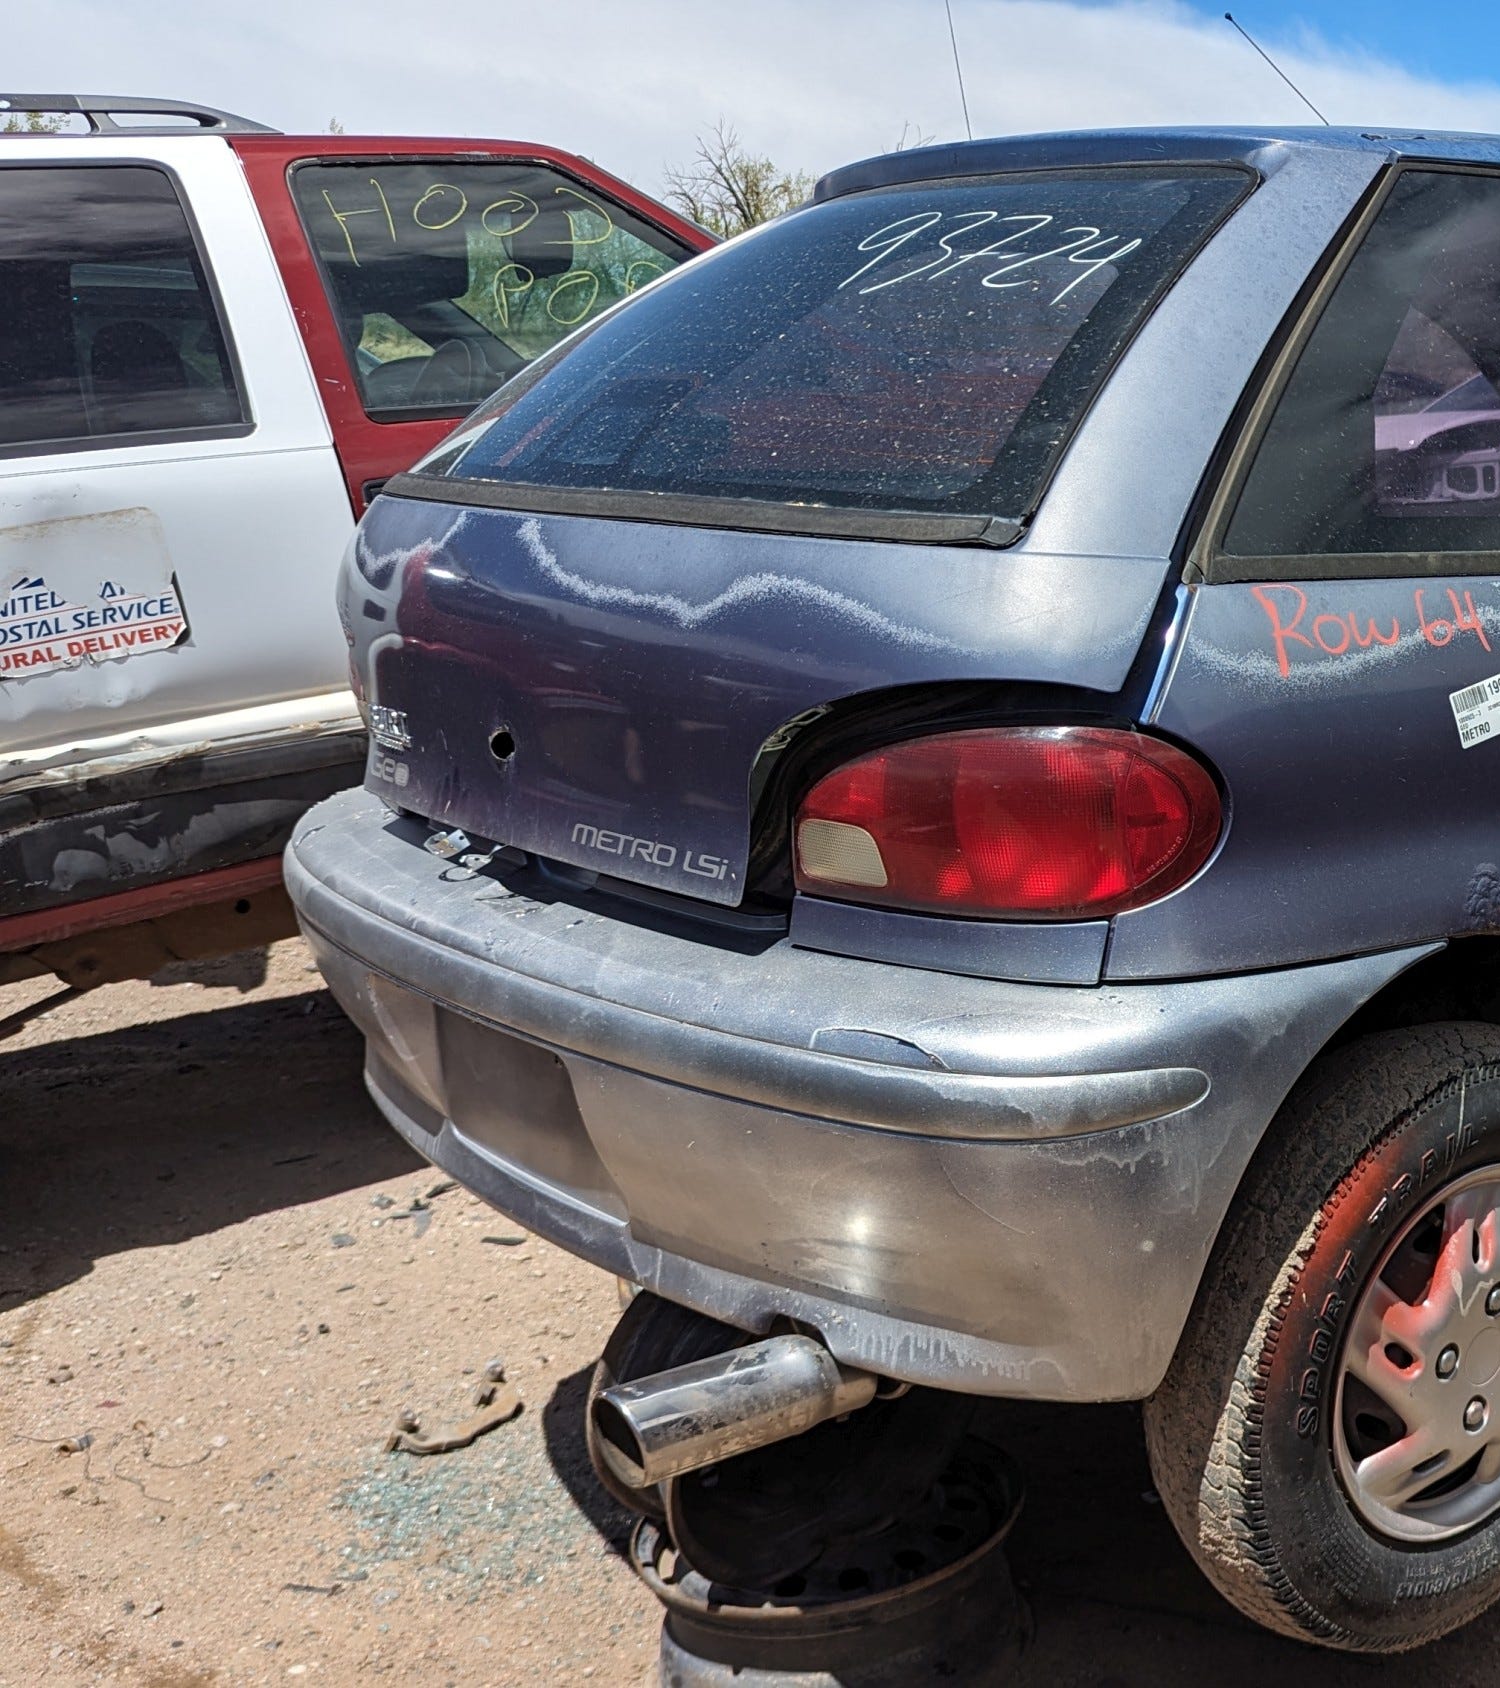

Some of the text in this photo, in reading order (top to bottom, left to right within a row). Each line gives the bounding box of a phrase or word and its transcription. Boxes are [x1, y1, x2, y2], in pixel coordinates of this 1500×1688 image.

[322, 178, 614, 267] HOOD
[67, 622, 185, 657] DELIVERY
[1251, 583, 1492, 680] Row 64
[1461, 721, 1491, 743] METRO
[571, 823, 729, 880] METRO LSi
[1297, 1250, 1356, 1437] SPORT
